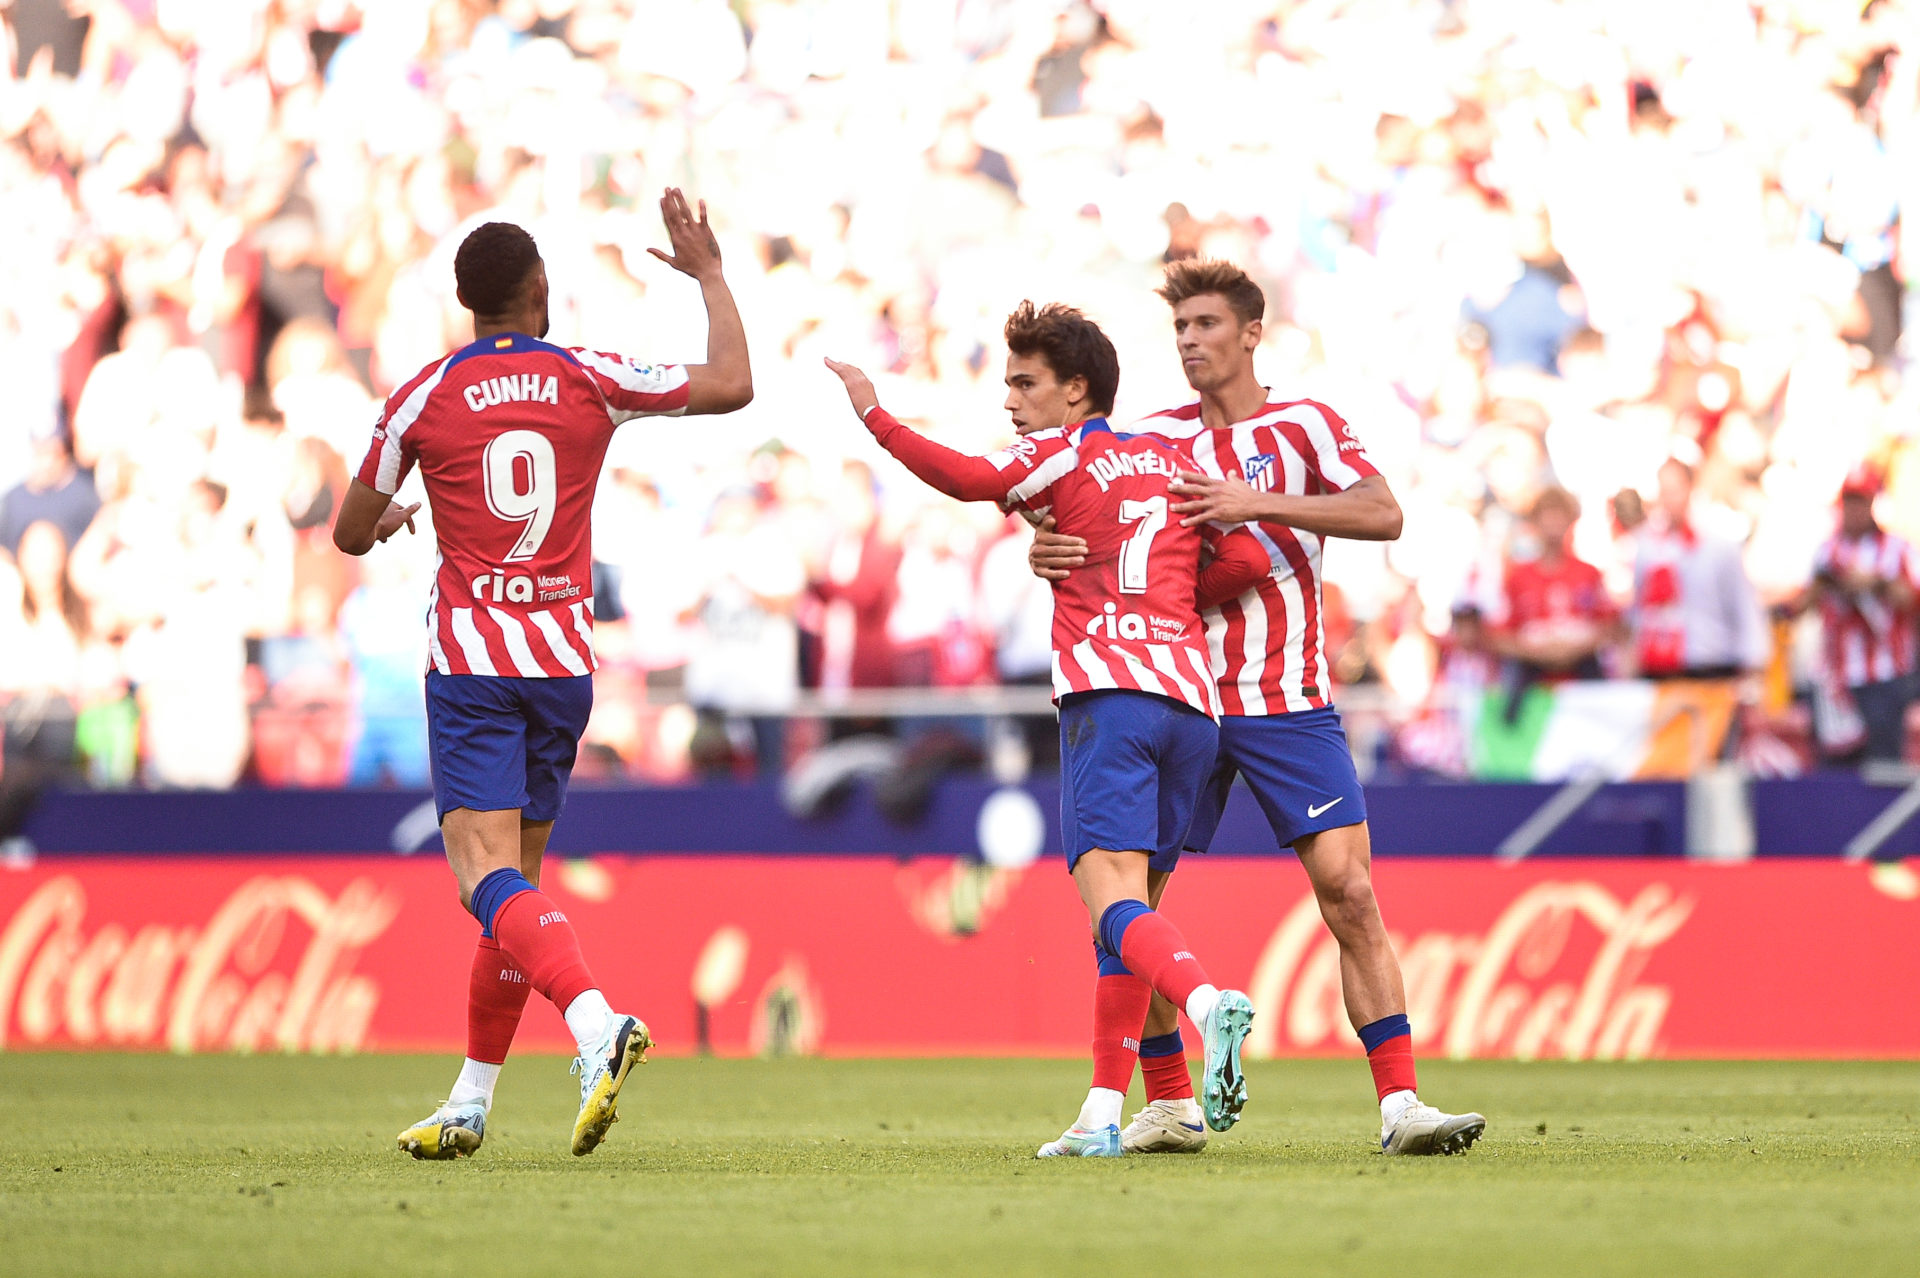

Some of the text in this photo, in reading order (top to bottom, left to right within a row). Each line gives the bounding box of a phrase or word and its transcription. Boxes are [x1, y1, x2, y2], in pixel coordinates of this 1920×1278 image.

[463, 373, 558, 413] CUNHA
[1131, 448, 1180, 482] FÉLI
[482, 429, 556, 563] 9
[1118, 495, 1168, 594] 7
[472, 568, 533, 603] ria
[537, 575, 572, 590] Money
[538, 585, 581, 602] Transfer
[1086, 601, 1148, 641] ria
[1149, 615, 1187, 636] Money
